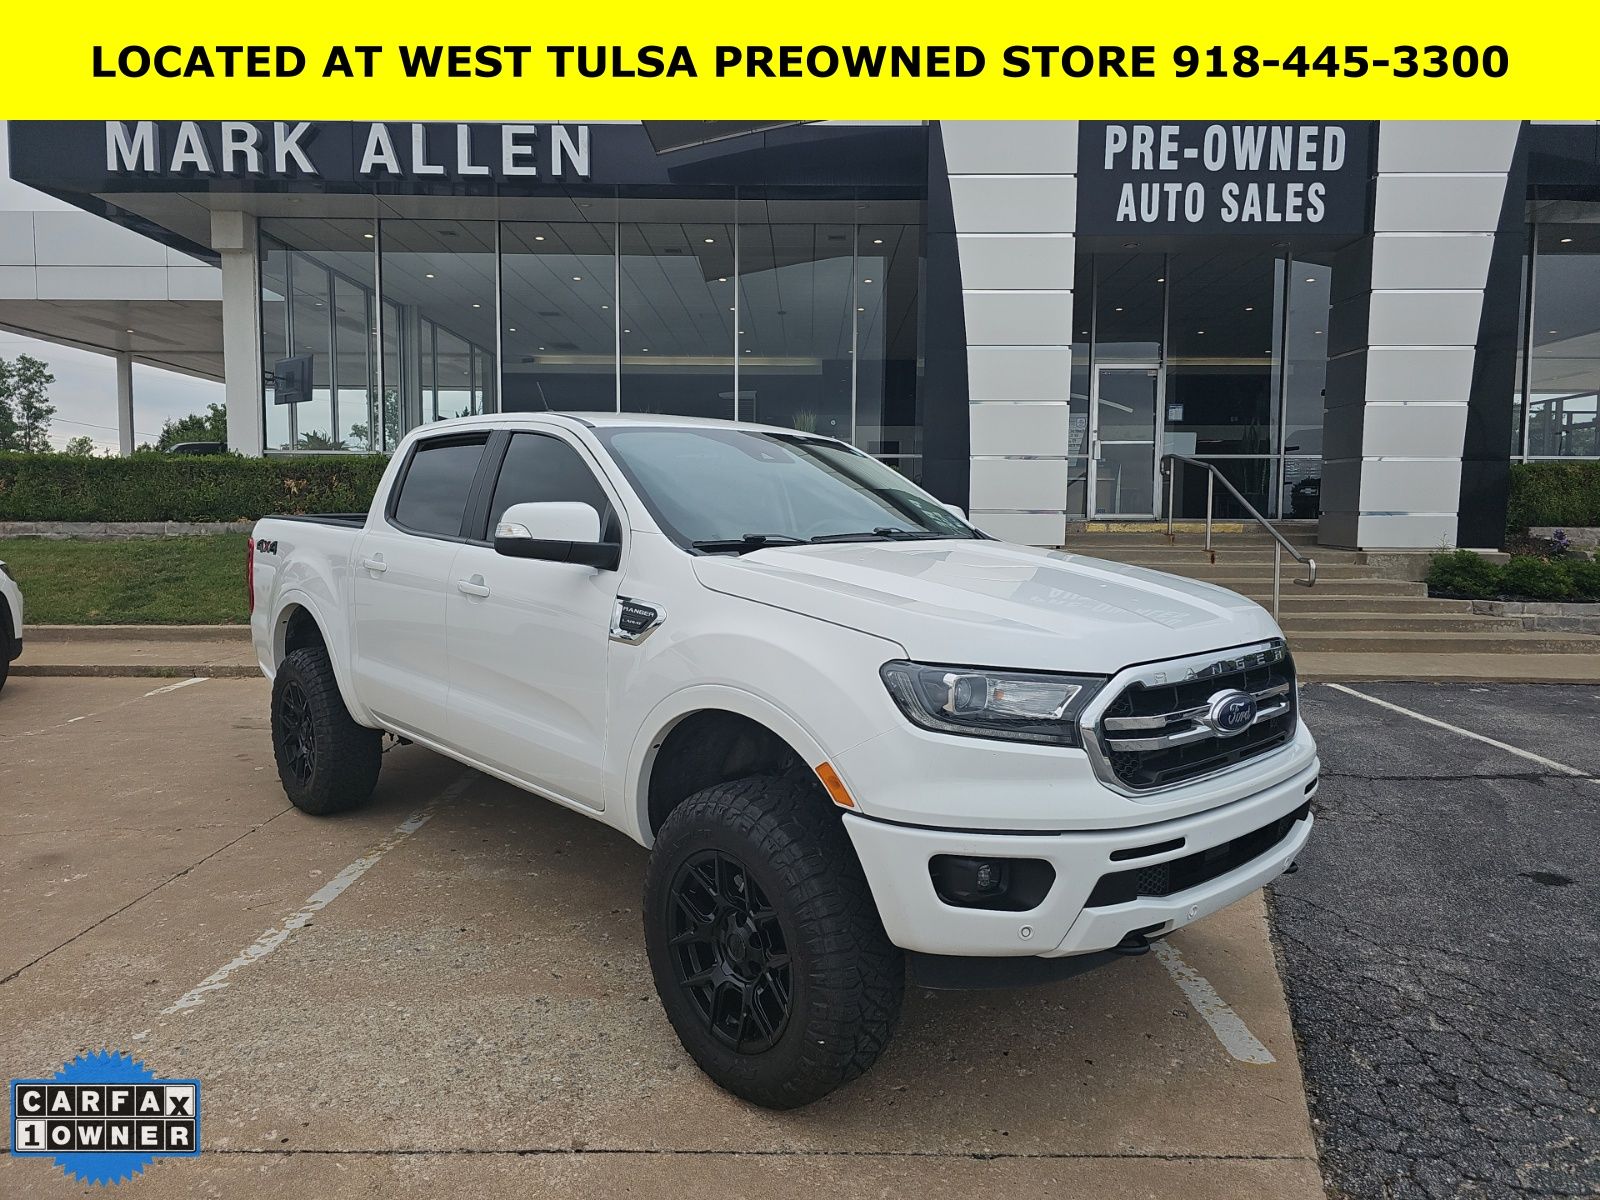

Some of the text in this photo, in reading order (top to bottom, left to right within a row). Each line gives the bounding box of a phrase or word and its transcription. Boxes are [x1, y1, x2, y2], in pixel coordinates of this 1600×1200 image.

[105, 120, 592, 178] MARK ALLEN
[1104, 124, 1346, 172] PRE-OWNED
[1115, 182, 1326, 223] AUTO SALES
[1154, 650, 1284, 684] RANGER
[1227, 701, 1252, 725] Ford
